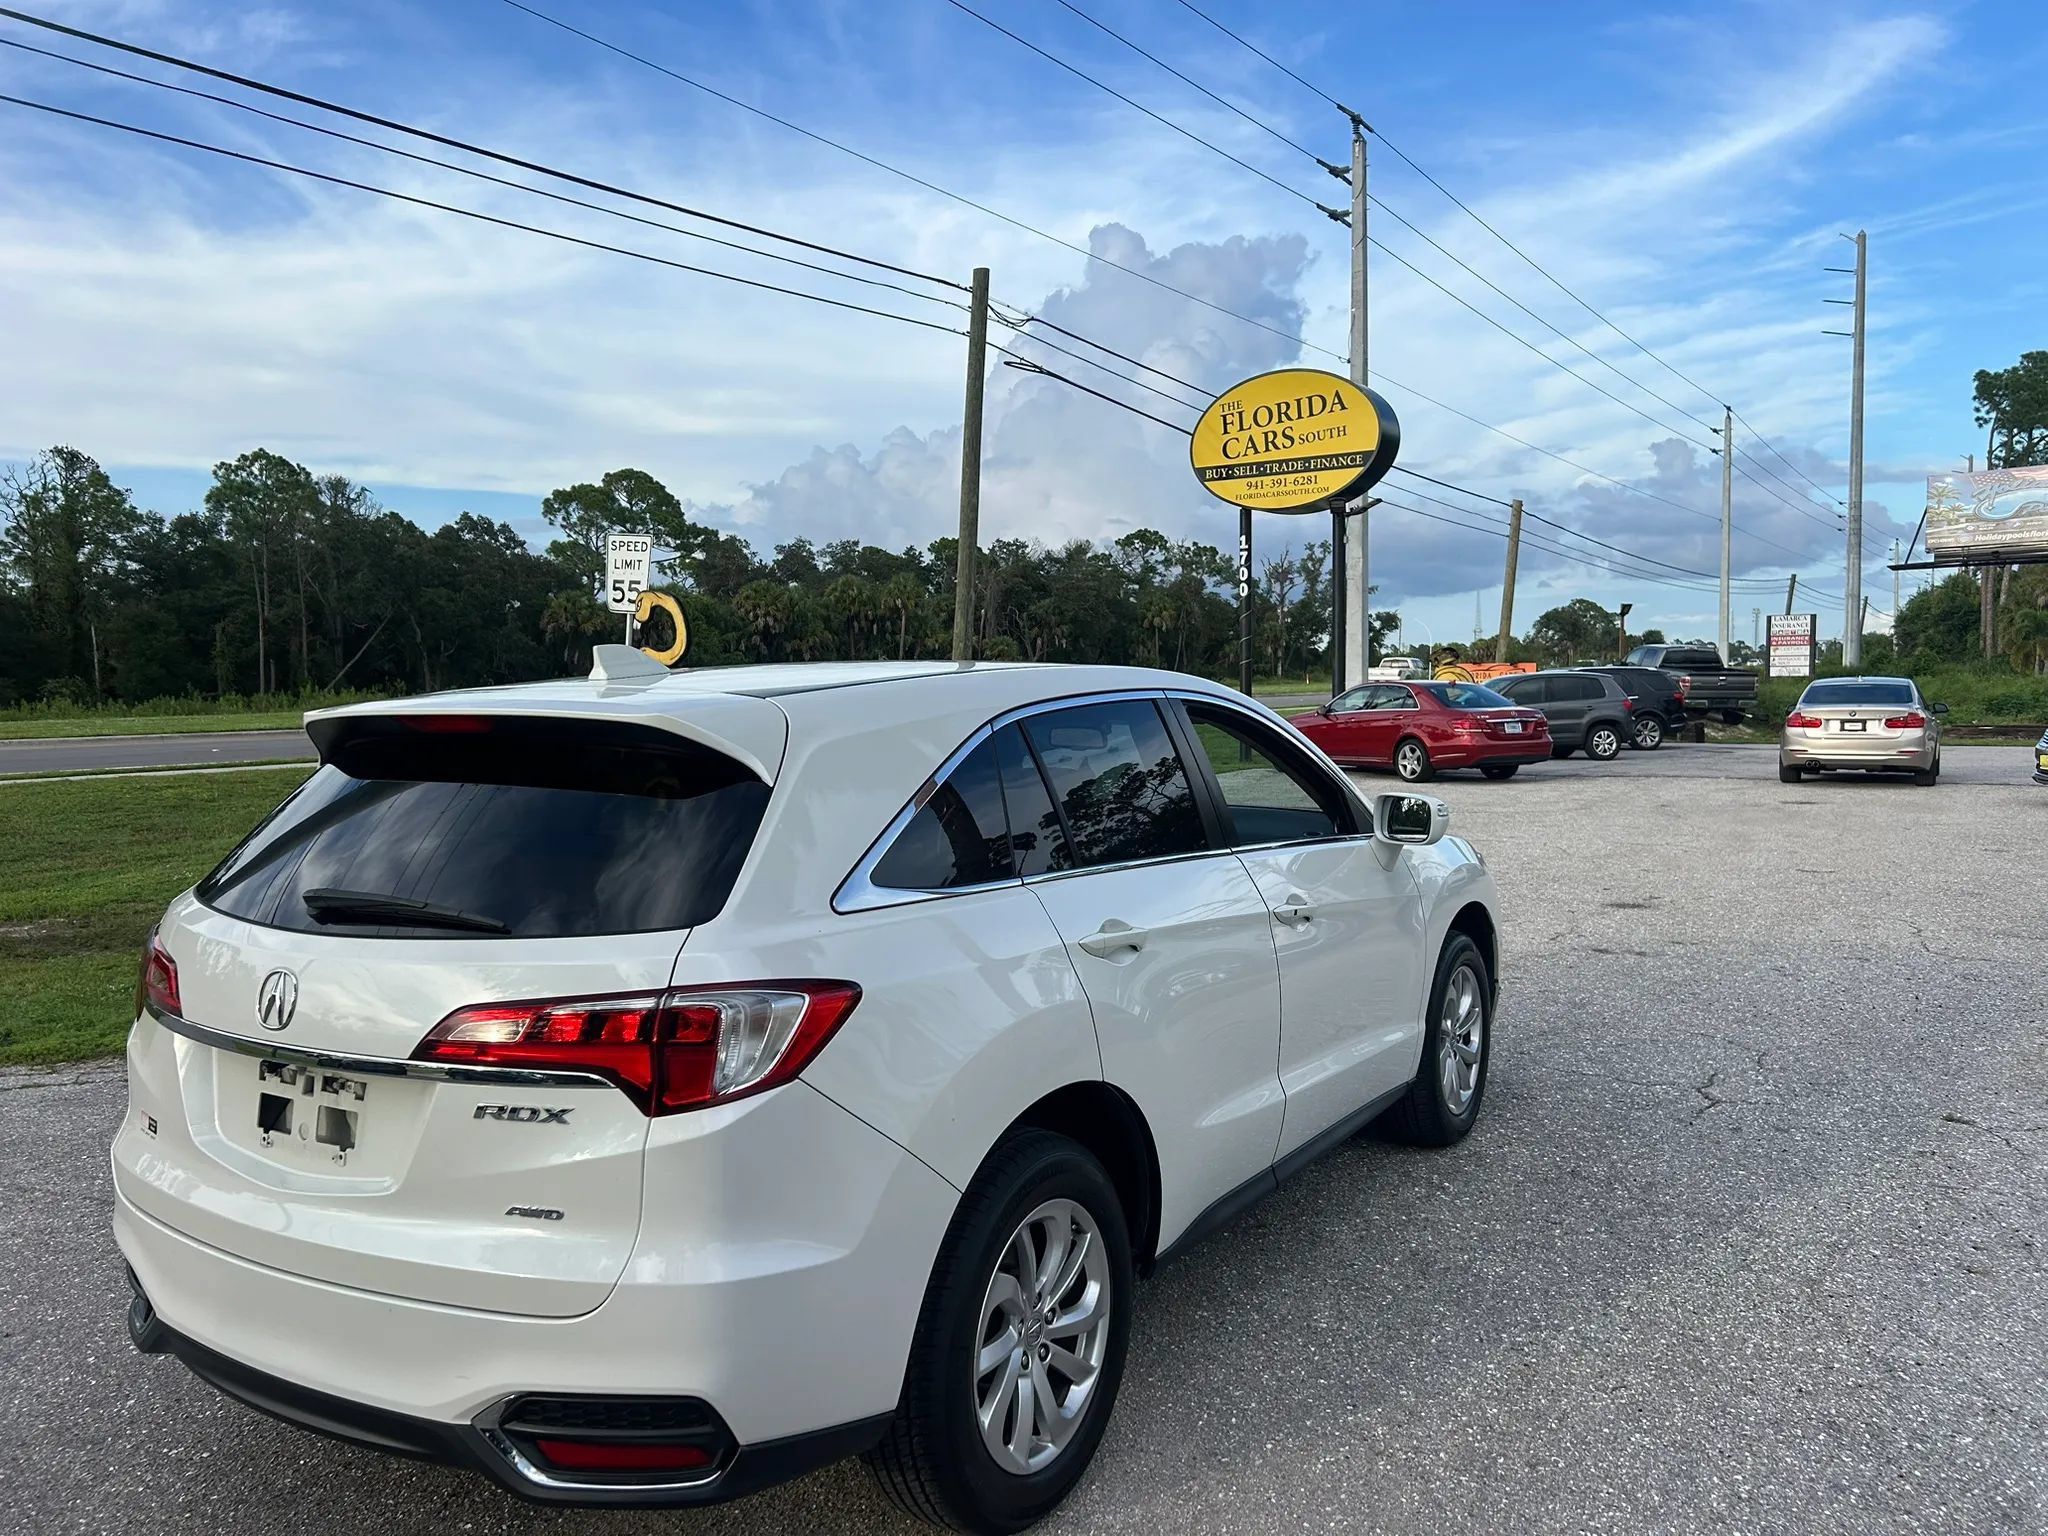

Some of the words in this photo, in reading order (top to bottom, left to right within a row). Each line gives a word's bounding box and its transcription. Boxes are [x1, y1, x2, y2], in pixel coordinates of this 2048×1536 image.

[1219, 400, 1243, 413] THE
[1220, 389, 1348, 435] FLORIDA
[1222, 426, 1295, 460] CARS
[1298, 425, 1347, 445] SOUTH
[1205, 467, 1228, 479] BUY
[1233, 465, 1259, 476] SELL
[1264, 460, 1304, 474] TRADE
[1310, 454, 1363, 469] FINANCE
[1246, 475, 1319, 490] 941-391-6281
[1235, 486, 1330, 500] FLORIDACARSSOUTH.COM
[611, 541, 648, 552] SPEED
[614, 559, 642, 570] LIMIT
[1240, 534, 1249, 596] 1700
[612, 579, 642, 604] 55
[473, 1102, 576, 1125] RDX
[504, 1205, 565, 1221] AWD
